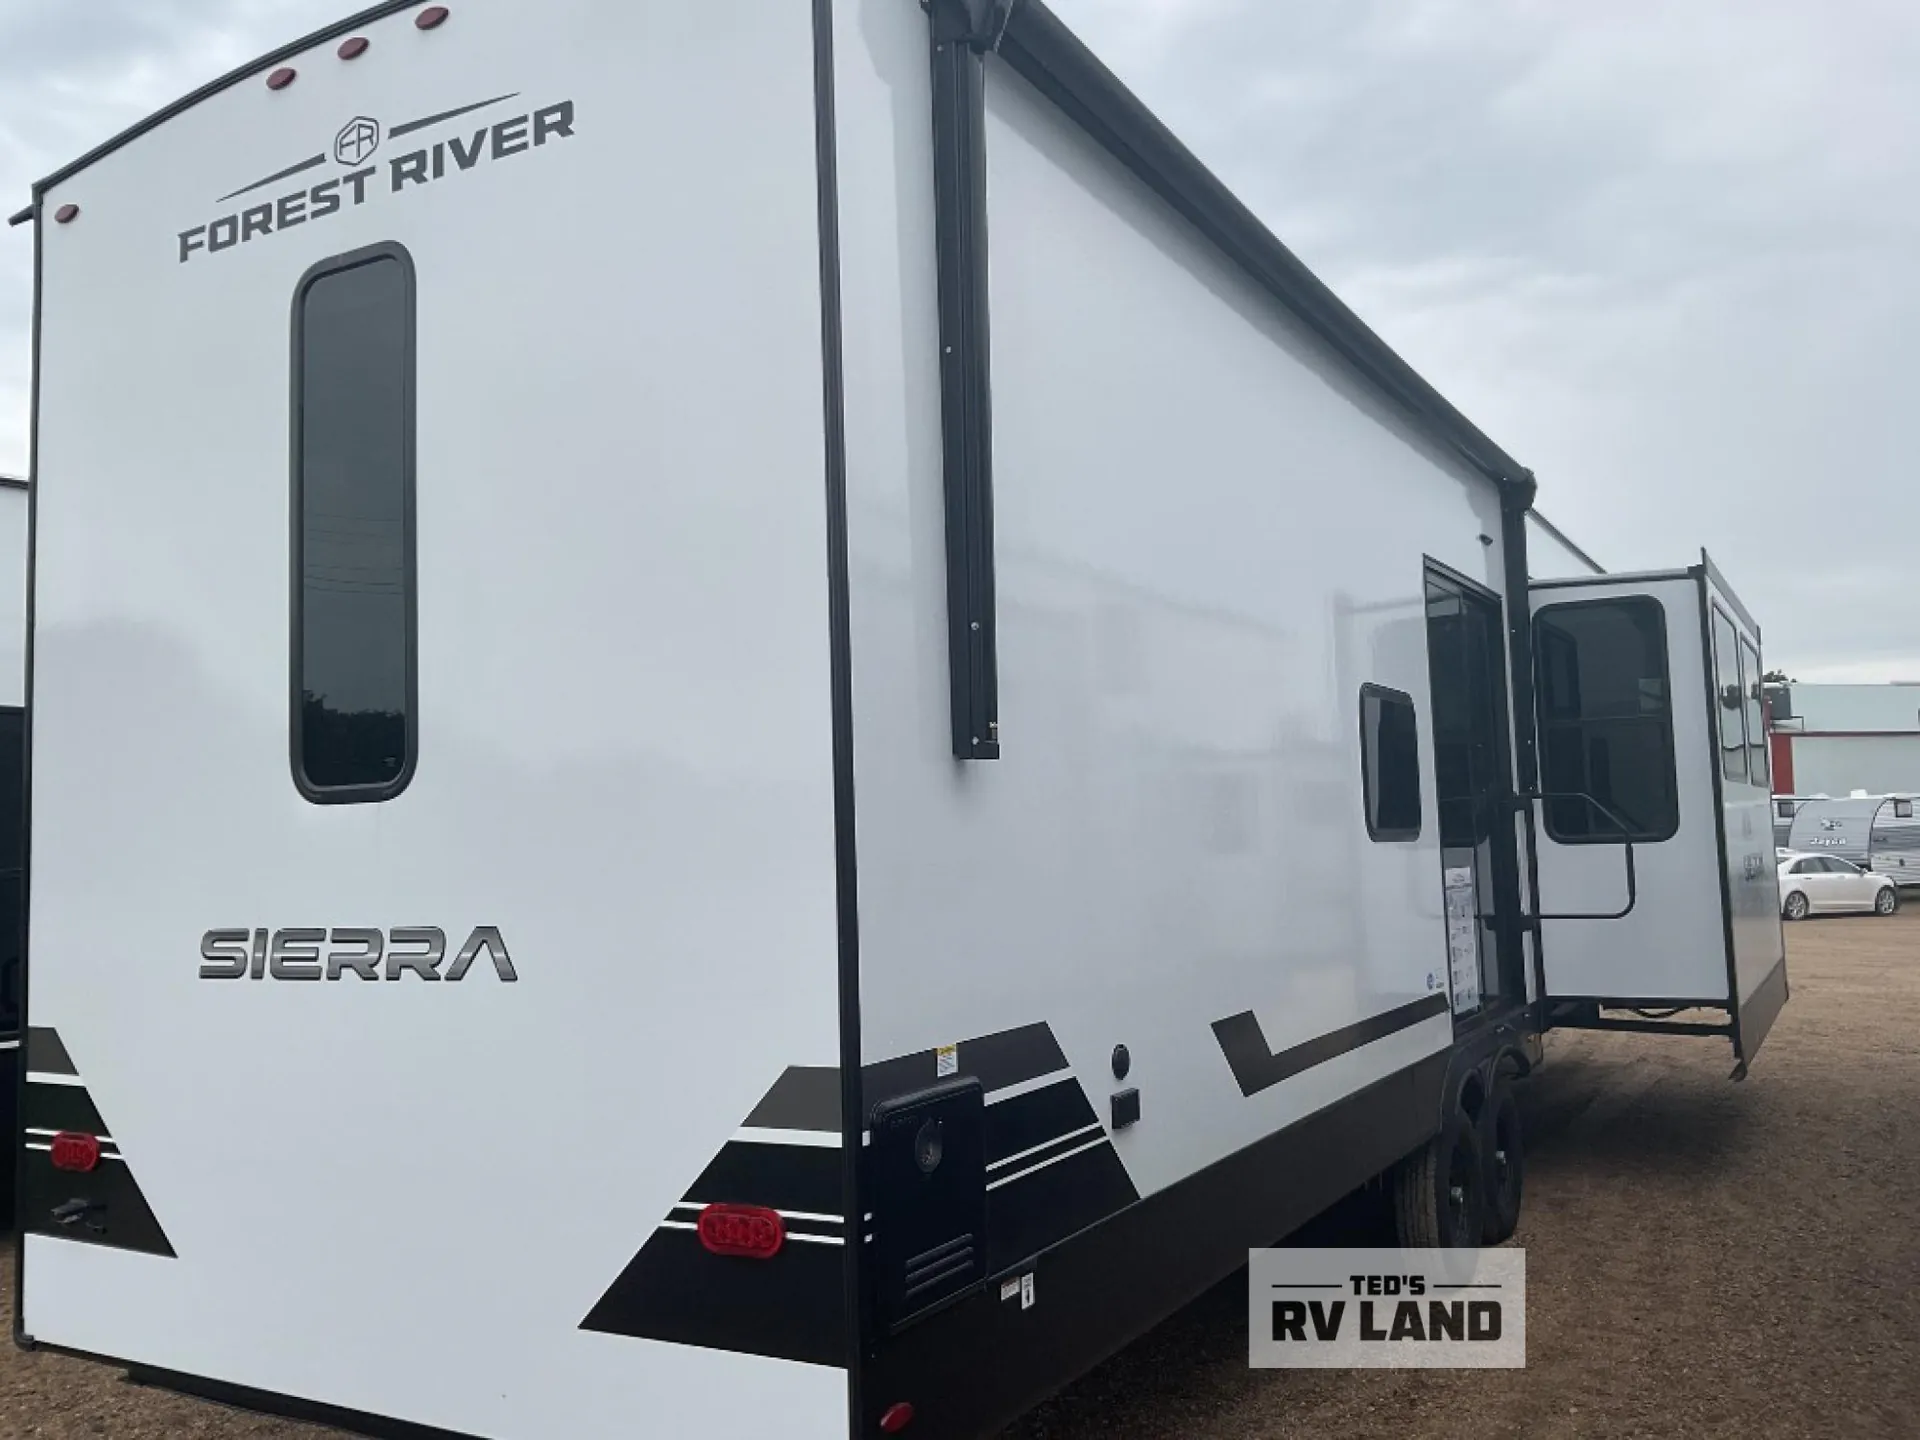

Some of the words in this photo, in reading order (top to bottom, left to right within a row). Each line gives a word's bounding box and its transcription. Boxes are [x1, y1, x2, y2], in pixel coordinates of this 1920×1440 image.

[178, 165, 376, 263] FOREST
[389, 99, 575, 192] RIVER
[198, 925, 518, 982] SIERRA
